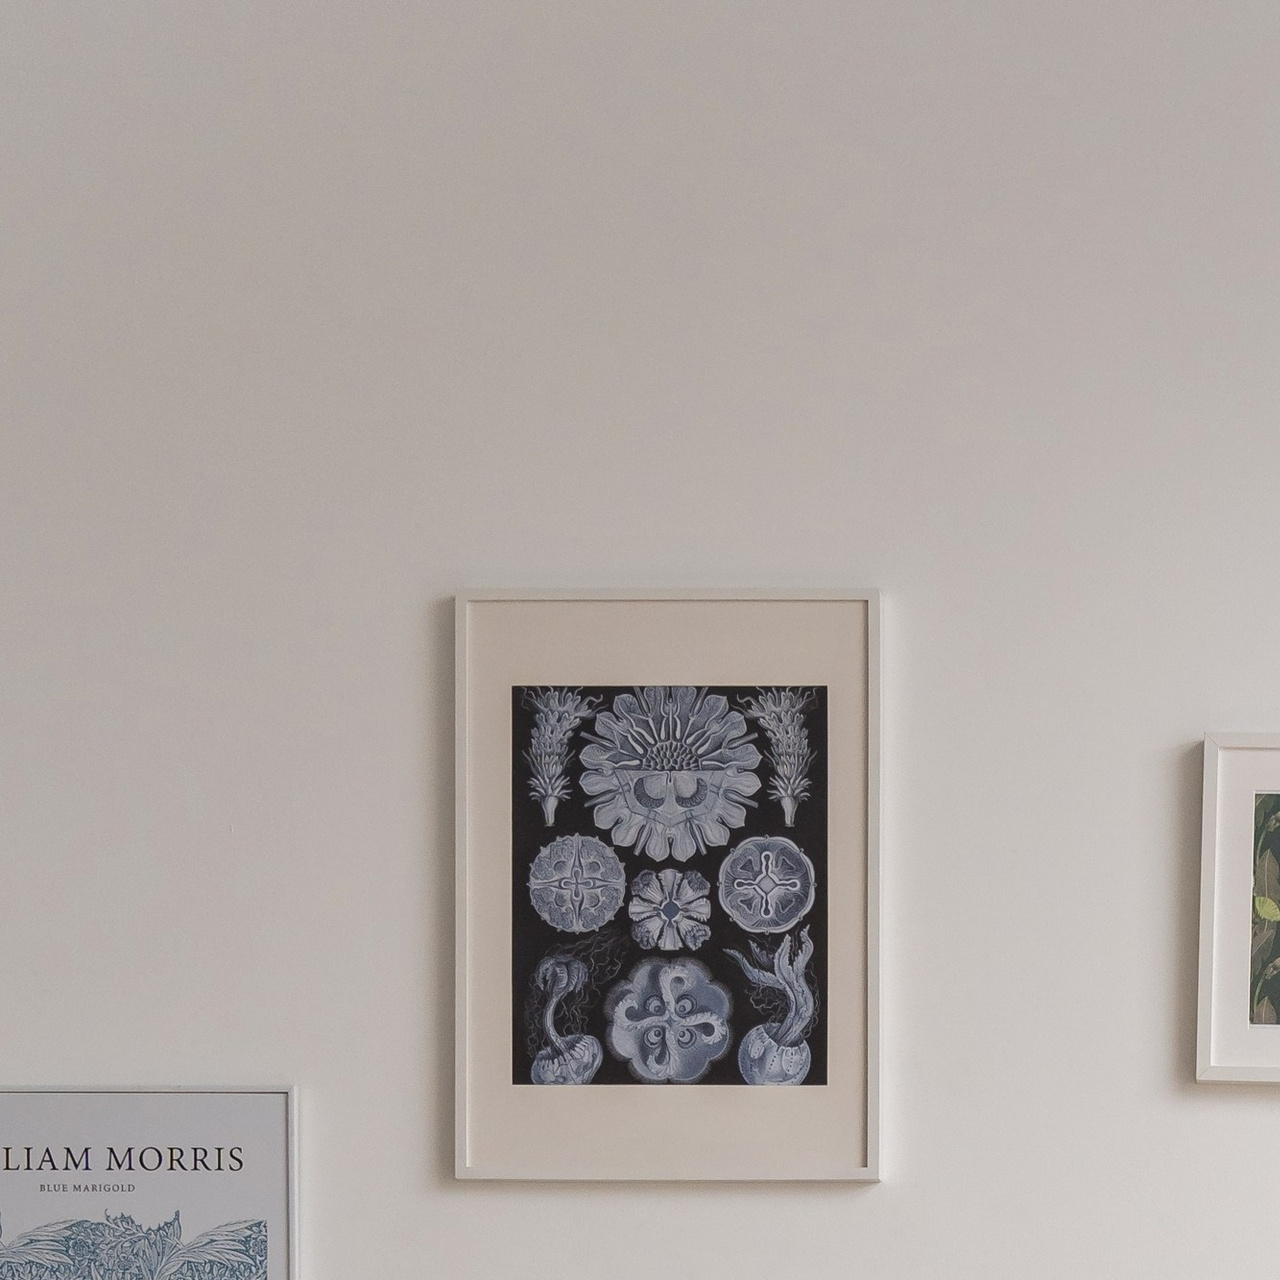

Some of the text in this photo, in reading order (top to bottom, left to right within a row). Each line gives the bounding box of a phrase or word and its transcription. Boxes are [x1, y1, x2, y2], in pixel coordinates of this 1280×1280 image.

[2, 1146, 244, 1172] LIAM MORRIS
[39, 1184, 136, 1193] BLUE MARIGOLD
